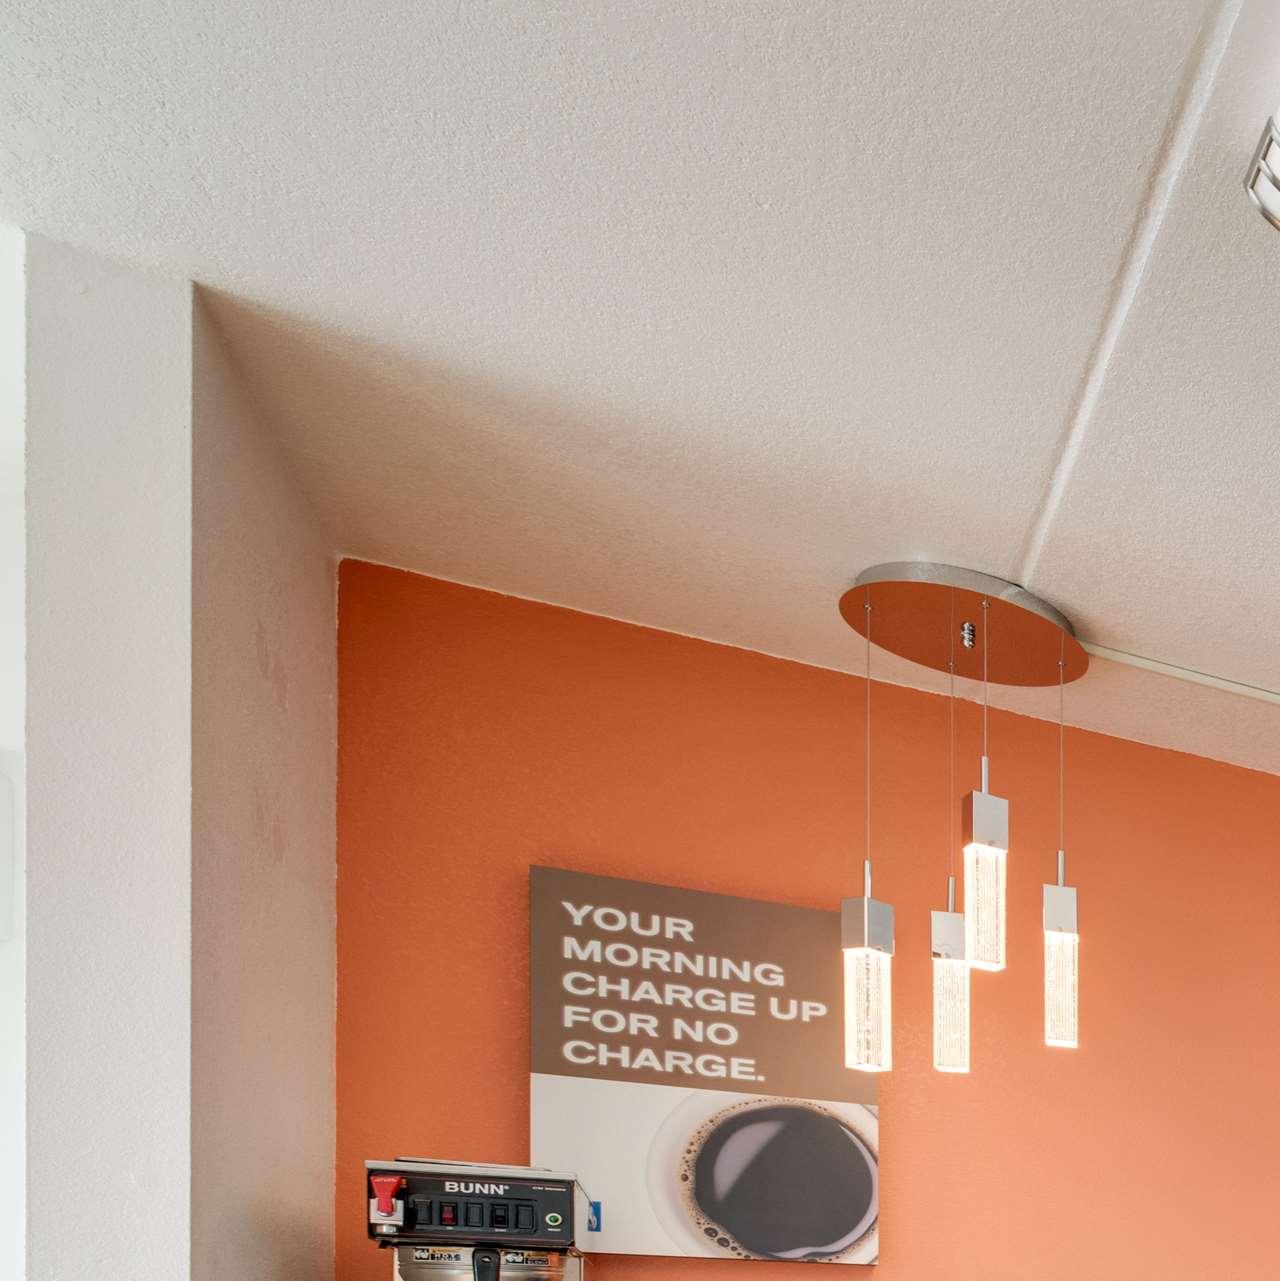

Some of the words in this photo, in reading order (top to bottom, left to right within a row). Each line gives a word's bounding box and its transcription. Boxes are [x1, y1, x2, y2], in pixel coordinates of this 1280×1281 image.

[560, 900, 695, 943] YOUR
[562, 935, 786, 988] MORNING
[562, 971, 757, 1017] CHARGE
[769, 996, 828, 1023] UP
[563, 1005, 660, 1038] FOR
[673, 1018, 739, 1047] NO
[562, 1040, 767, 1082] CHARGE.
[444, 1181, 505, 1196] BUNN
